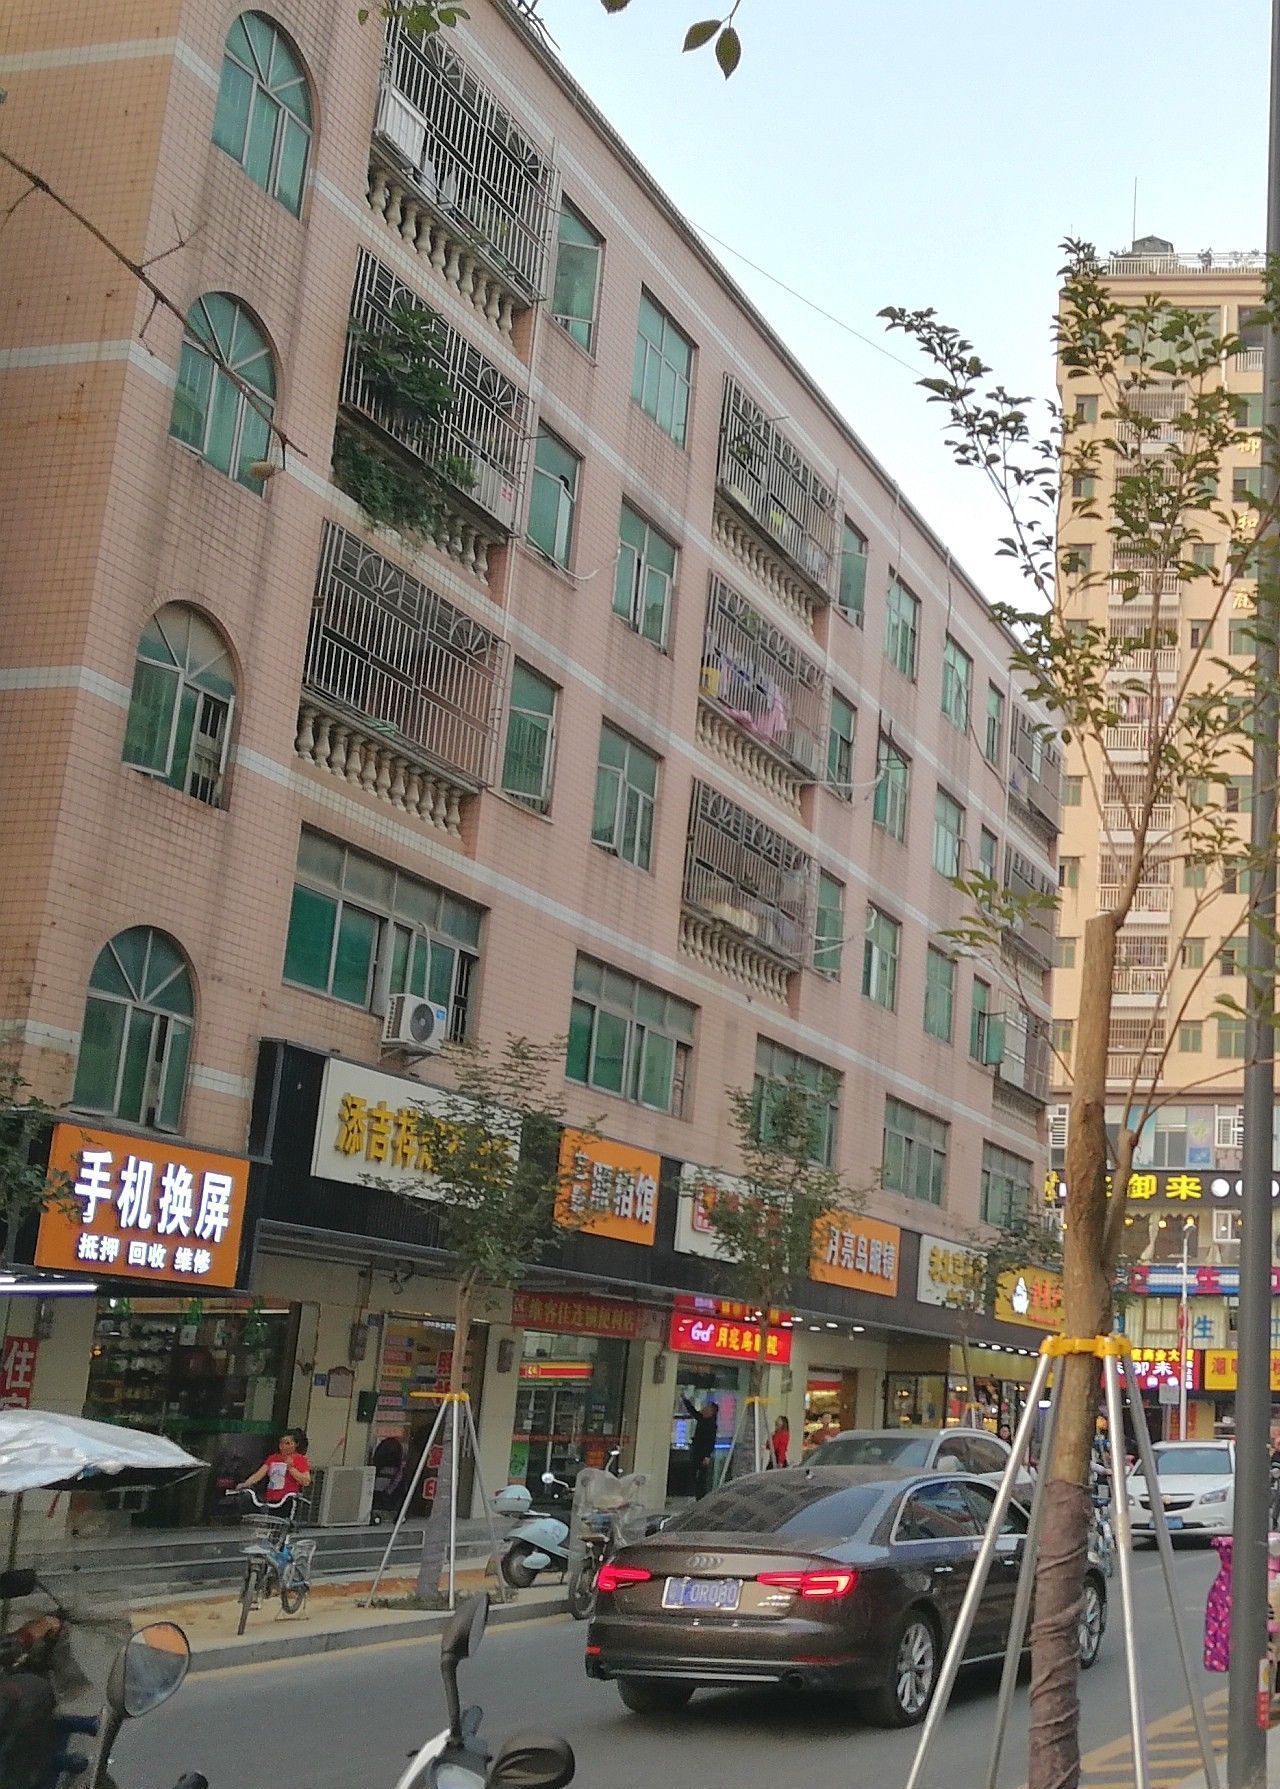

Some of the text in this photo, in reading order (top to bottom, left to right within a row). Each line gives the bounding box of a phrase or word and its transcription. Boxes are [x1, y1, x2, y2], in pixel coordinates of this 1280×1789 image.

[74, 1150, 234, 1244] 手机换屏
[1104, 1172, 1203, 1201] 御来
[78, 1232, 213, 1276] 抵押 回收 维修
[826, 1226, 896, 1280] 月亮岛眼镜
